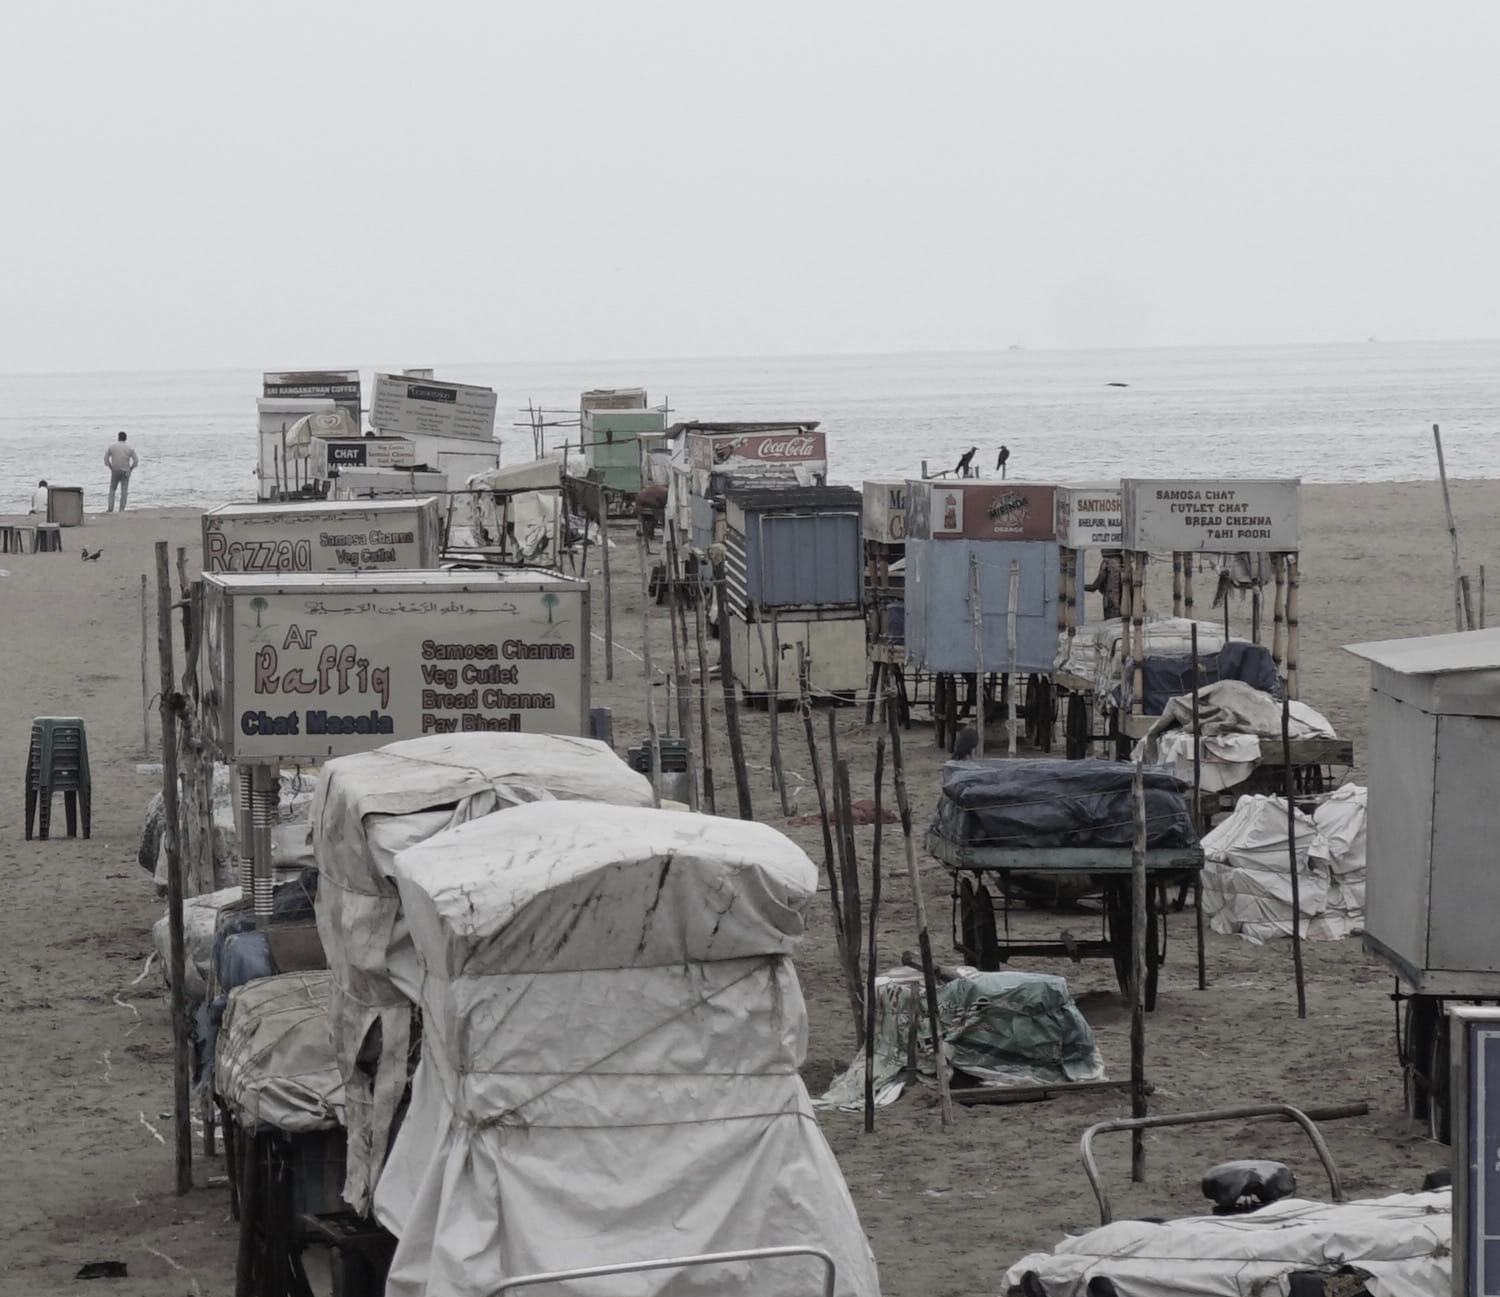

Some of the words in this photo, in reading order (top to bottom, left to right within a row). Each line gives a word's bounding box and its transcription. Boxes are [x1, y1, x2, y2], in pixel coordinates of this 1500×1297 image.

[331, 385, 357, 393] COFFEE
[335, 449, 359, 458] CHAT
[1156, 490, 1201, 500] SAMOSA
[1205, 490, 1236, 500] CHAT
[1219, 503, 1249, 513] CHAT
[1185, 516, 1222, 526] BREAD
[1226, 516, 1272, 526] CHENNA
[320, 531, 368, 547] Samosa
[368, 530, 414, 546] Channa
[336, 548, 359, 565] Veg
[283, 624, 317, 649] Ar
[421, 640, 498, 660] Samosa
[502, 640, 575, 660] Channa
[421, 664, 458, 688] Veg
[461, 664, 518, 686] Cutlet
[422, 689, 478, 710] Bread
[482, 689, 555, 710] Channa
[241, 710, 299, 735] Chat
[306, 710, 393, 735] Masala
